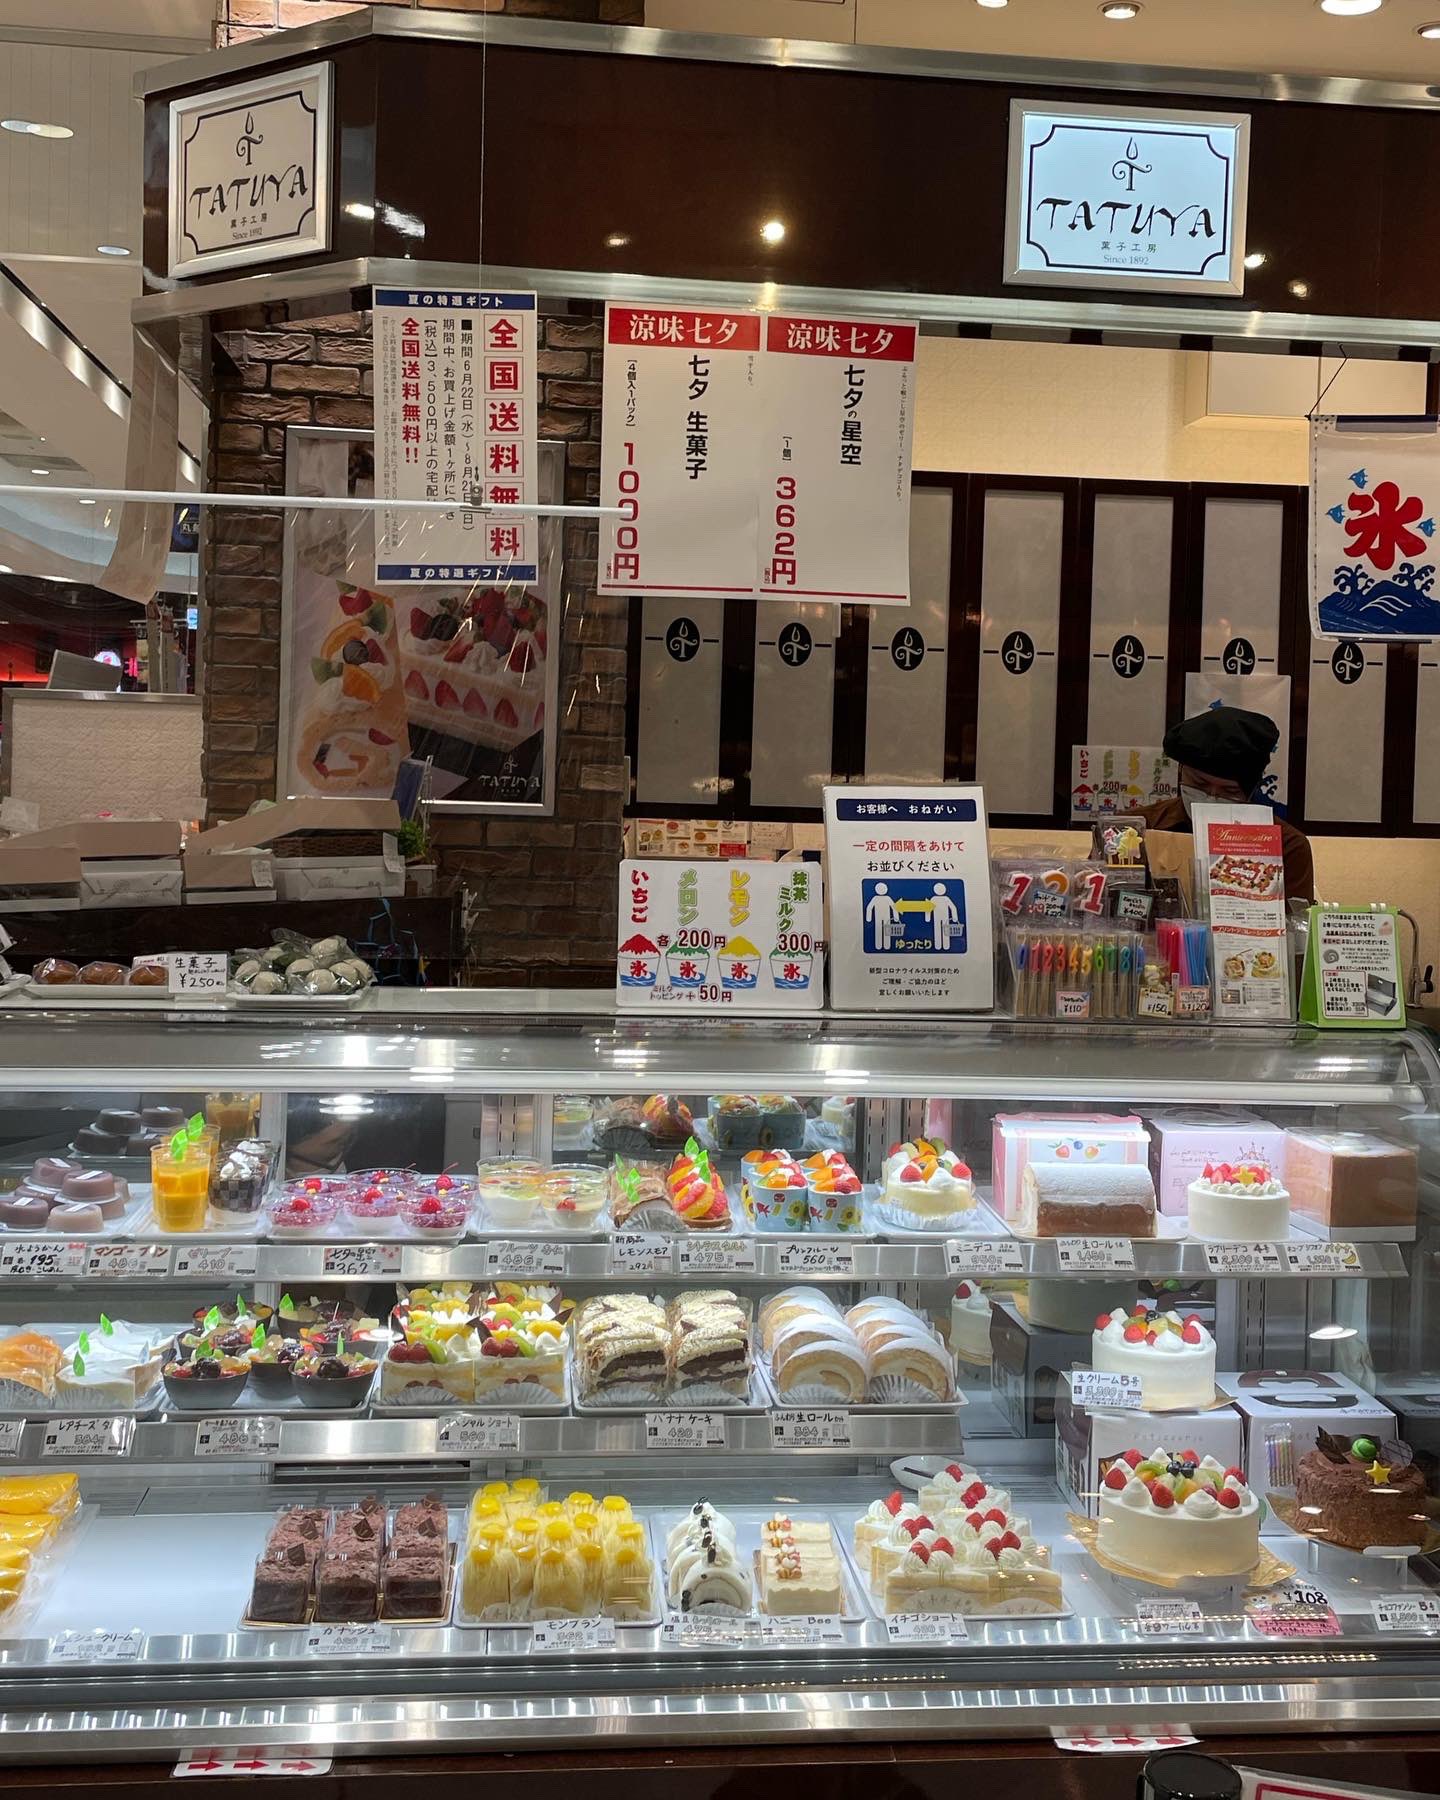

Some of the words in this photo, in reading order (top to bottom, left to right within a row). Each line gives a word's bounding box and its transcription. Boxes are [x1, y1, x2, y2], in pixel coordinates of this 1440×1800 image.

[189, 164, 308, 220] TATUYA
[230, 212, 268, 228] 菓子工房
[1036, 197, 1216, 238] TATUYA
[232, 229, 249, 240] Since
[1100, 241, 1158, 253] 菓子工房
[1103, 254, 1128, 265] Since
[1129, 256, 1150, 266] 1892
[408, 293, 505, 307] 夏の特選ギフト
[629, 313, 739, 345] 涼味七夕
[786, 322, 895, 355] 涼味七夕
[688, 355, 711, 400] 七夕
[401, 317, 422, 464] 全国送料無料!!
[840, 364, 865, 466] 七夕の星空
[488, 318, 520, 557] 全国送料無料
[685, 411, 709, 480] 生菓子
[613, 442, 641, 580] 1000円
[771, 475, 798, 586] 362円
[1343, 481, 1428, 571] 氷
[410, 567, 506, 579] 夏の特選ギフト
[479, 775, 541, 788] TATUYA
[856, 804, 898, 815] お客様へ
[908, 804, 957, 815] おねがい
[853, 840, 965, 852] 一定の間隔をあけて
[867, 860, 955, 872] お並びください
[792, 870, 809, 902] 抹茶
[630, 870, 650, 924] いちご
[677, 869, 699, 926] メロン
[728, 869, 751, 928] レモン
[776, 887, 795, 933] ミルク
[657, 934, 670, 947] 各
[678, 929, 727, 949] 200円
[778, 933, 825, 952] 300円
[895, 938, 932, 950] ゆったり
[175, 956, 218, 969] 生菓子
[630, 960, 648, 978] 氷
[679, 960, 697, 979] 氷
[730, 962, 749, 980] 氷
[869, 967, 960, 975] 新型コロナウイルス対策のため
[179, 972, 215, 988] ¥250
[783, 963, 801, 980] 氷
[699, 984, 733, 1003] 50円
[957, 1242, 993, 1253] ミニデコ
[30, 1254, 58, 1265] 195
[694, 1252, 725, 1263] 475
[803, 1255, 826, 1265] 560
[336, 1262, 369, 1275] 362
[688, 1413, 713, 1425] ケーキ
[796, 1411, 834, 1423] 生ロール
[1283, 1590, 1328, 1605] ¥108
[807, 1616, 832, 1625] Bee
